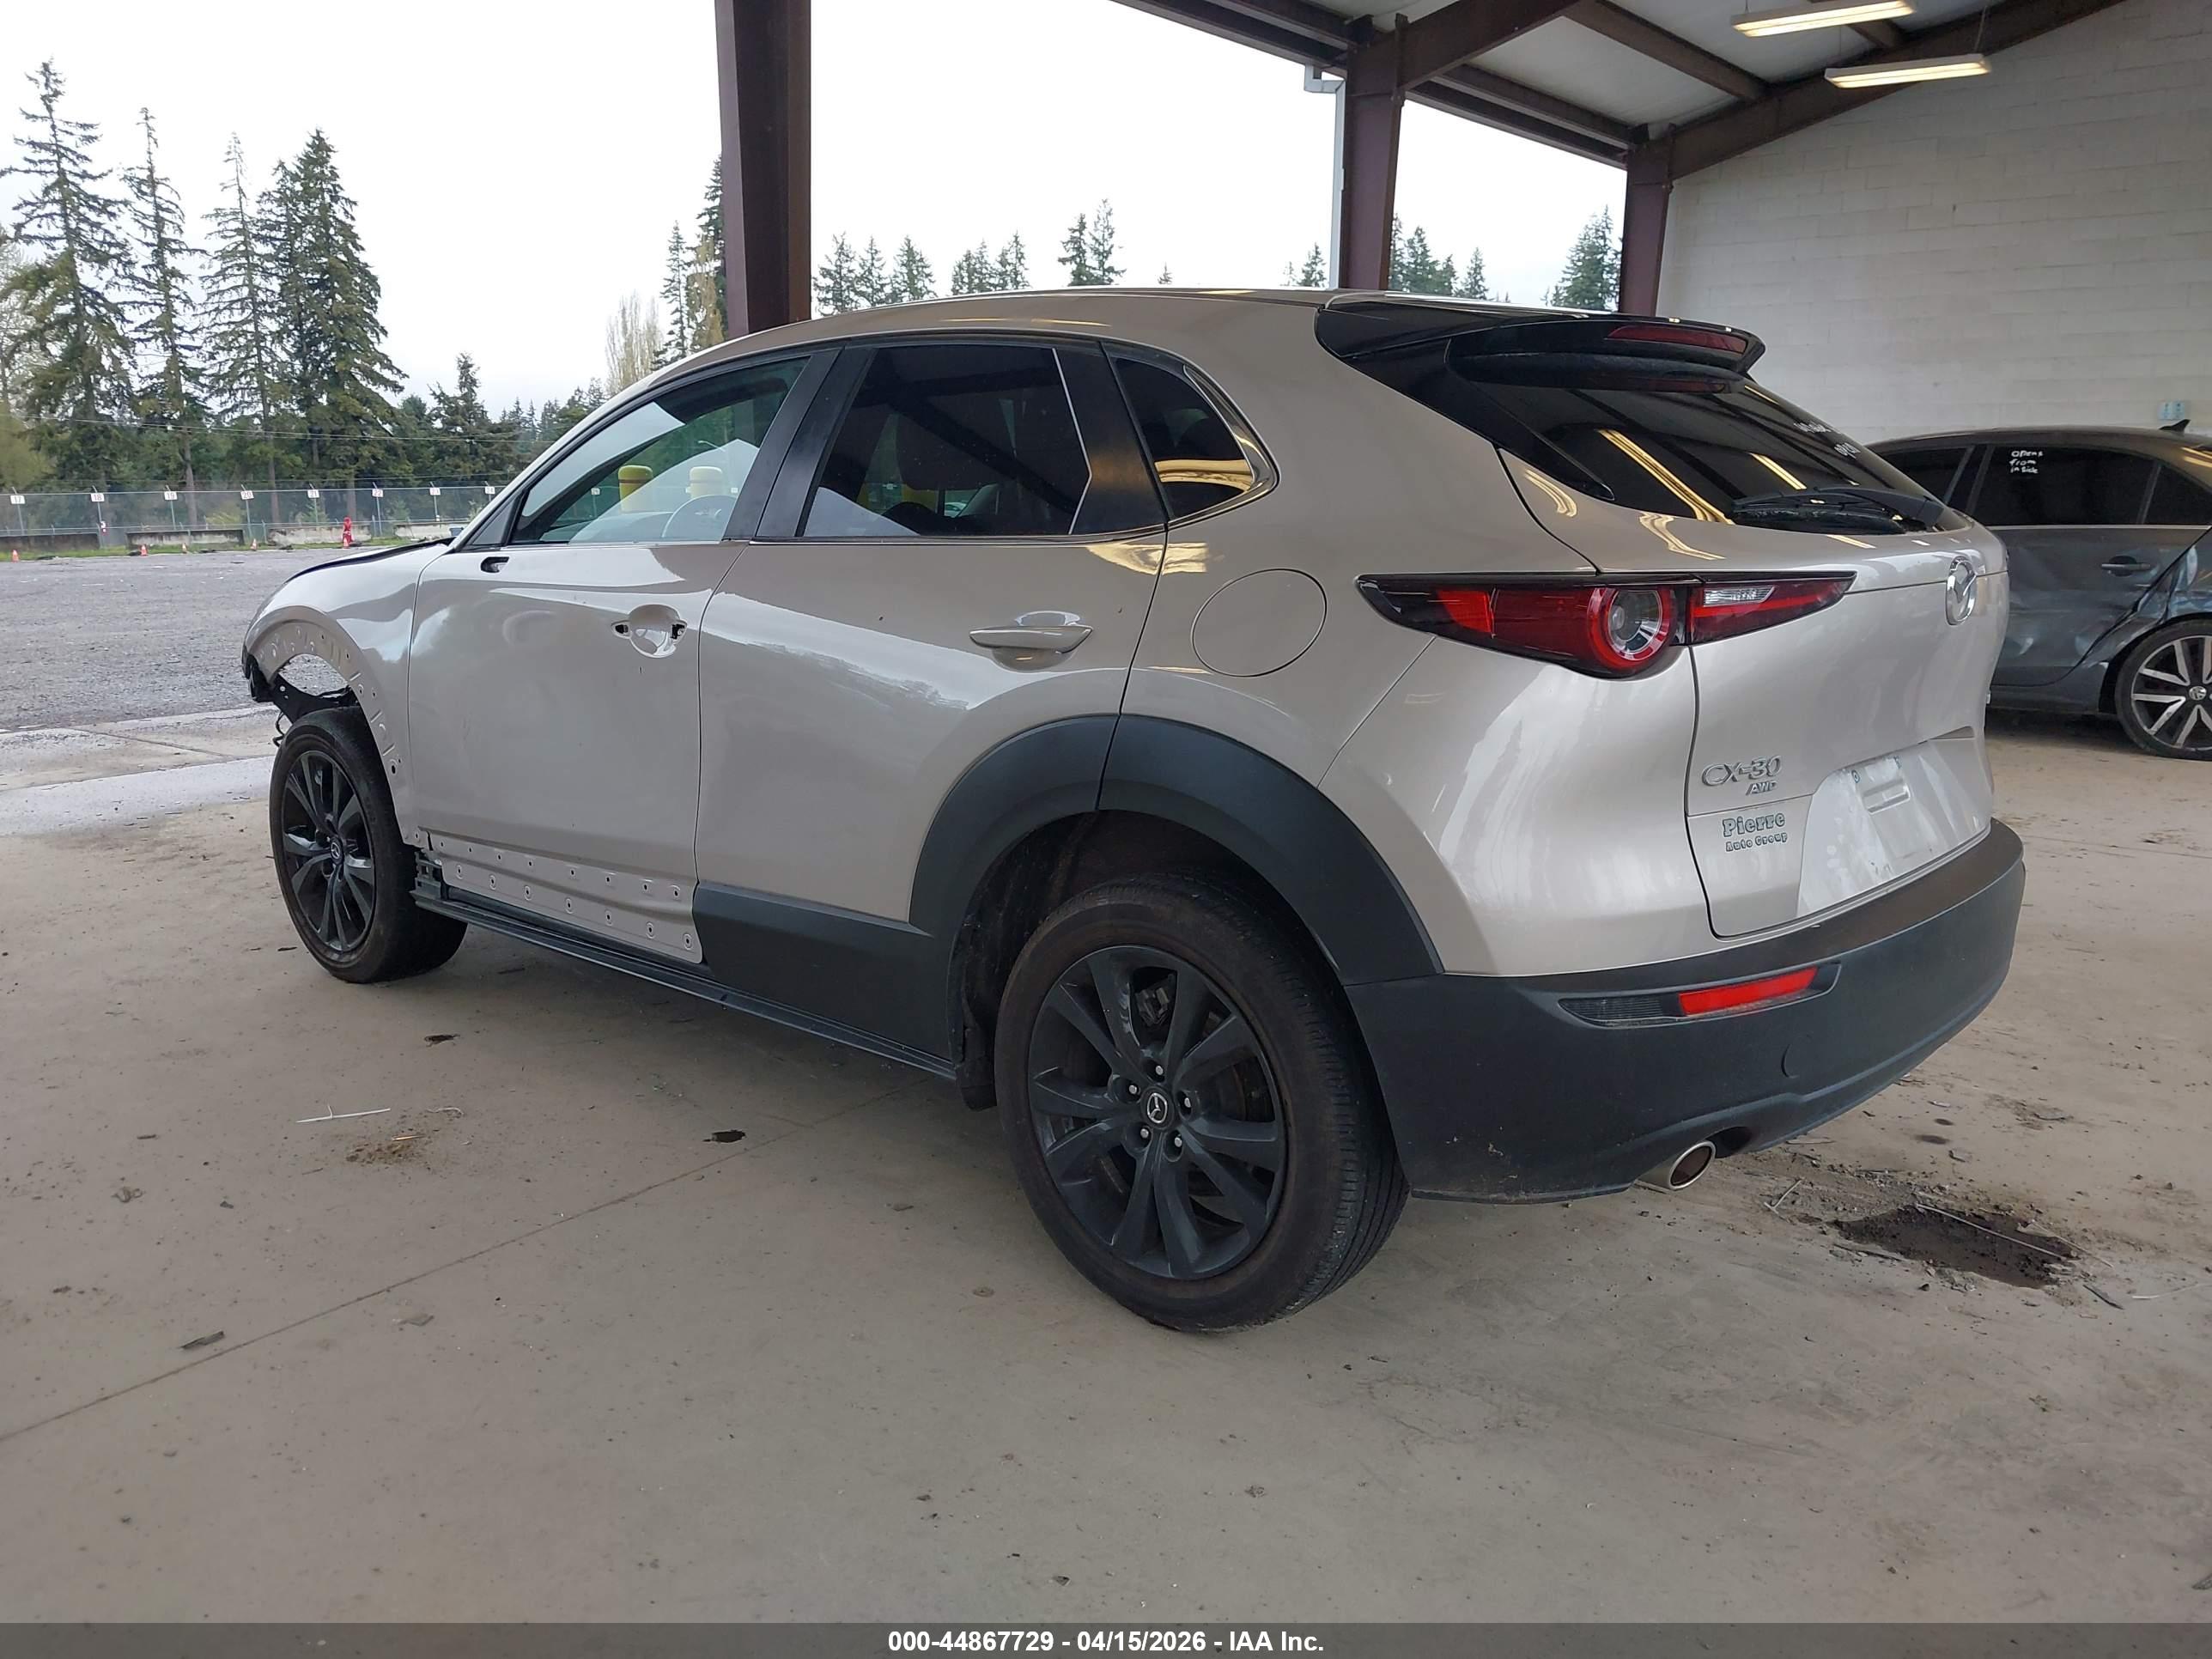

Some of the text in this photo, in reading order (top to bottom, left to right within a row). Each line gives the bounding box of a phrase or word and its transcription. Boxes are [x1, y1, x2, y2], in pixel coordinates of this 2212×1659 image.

[1701, 755, 1782, 787] CX-30
[1745, 779, 1778, 797] AWD
[1722, 811, 1786, 838] Pierre
[1725, 831, 1789, 853] Auto Group
